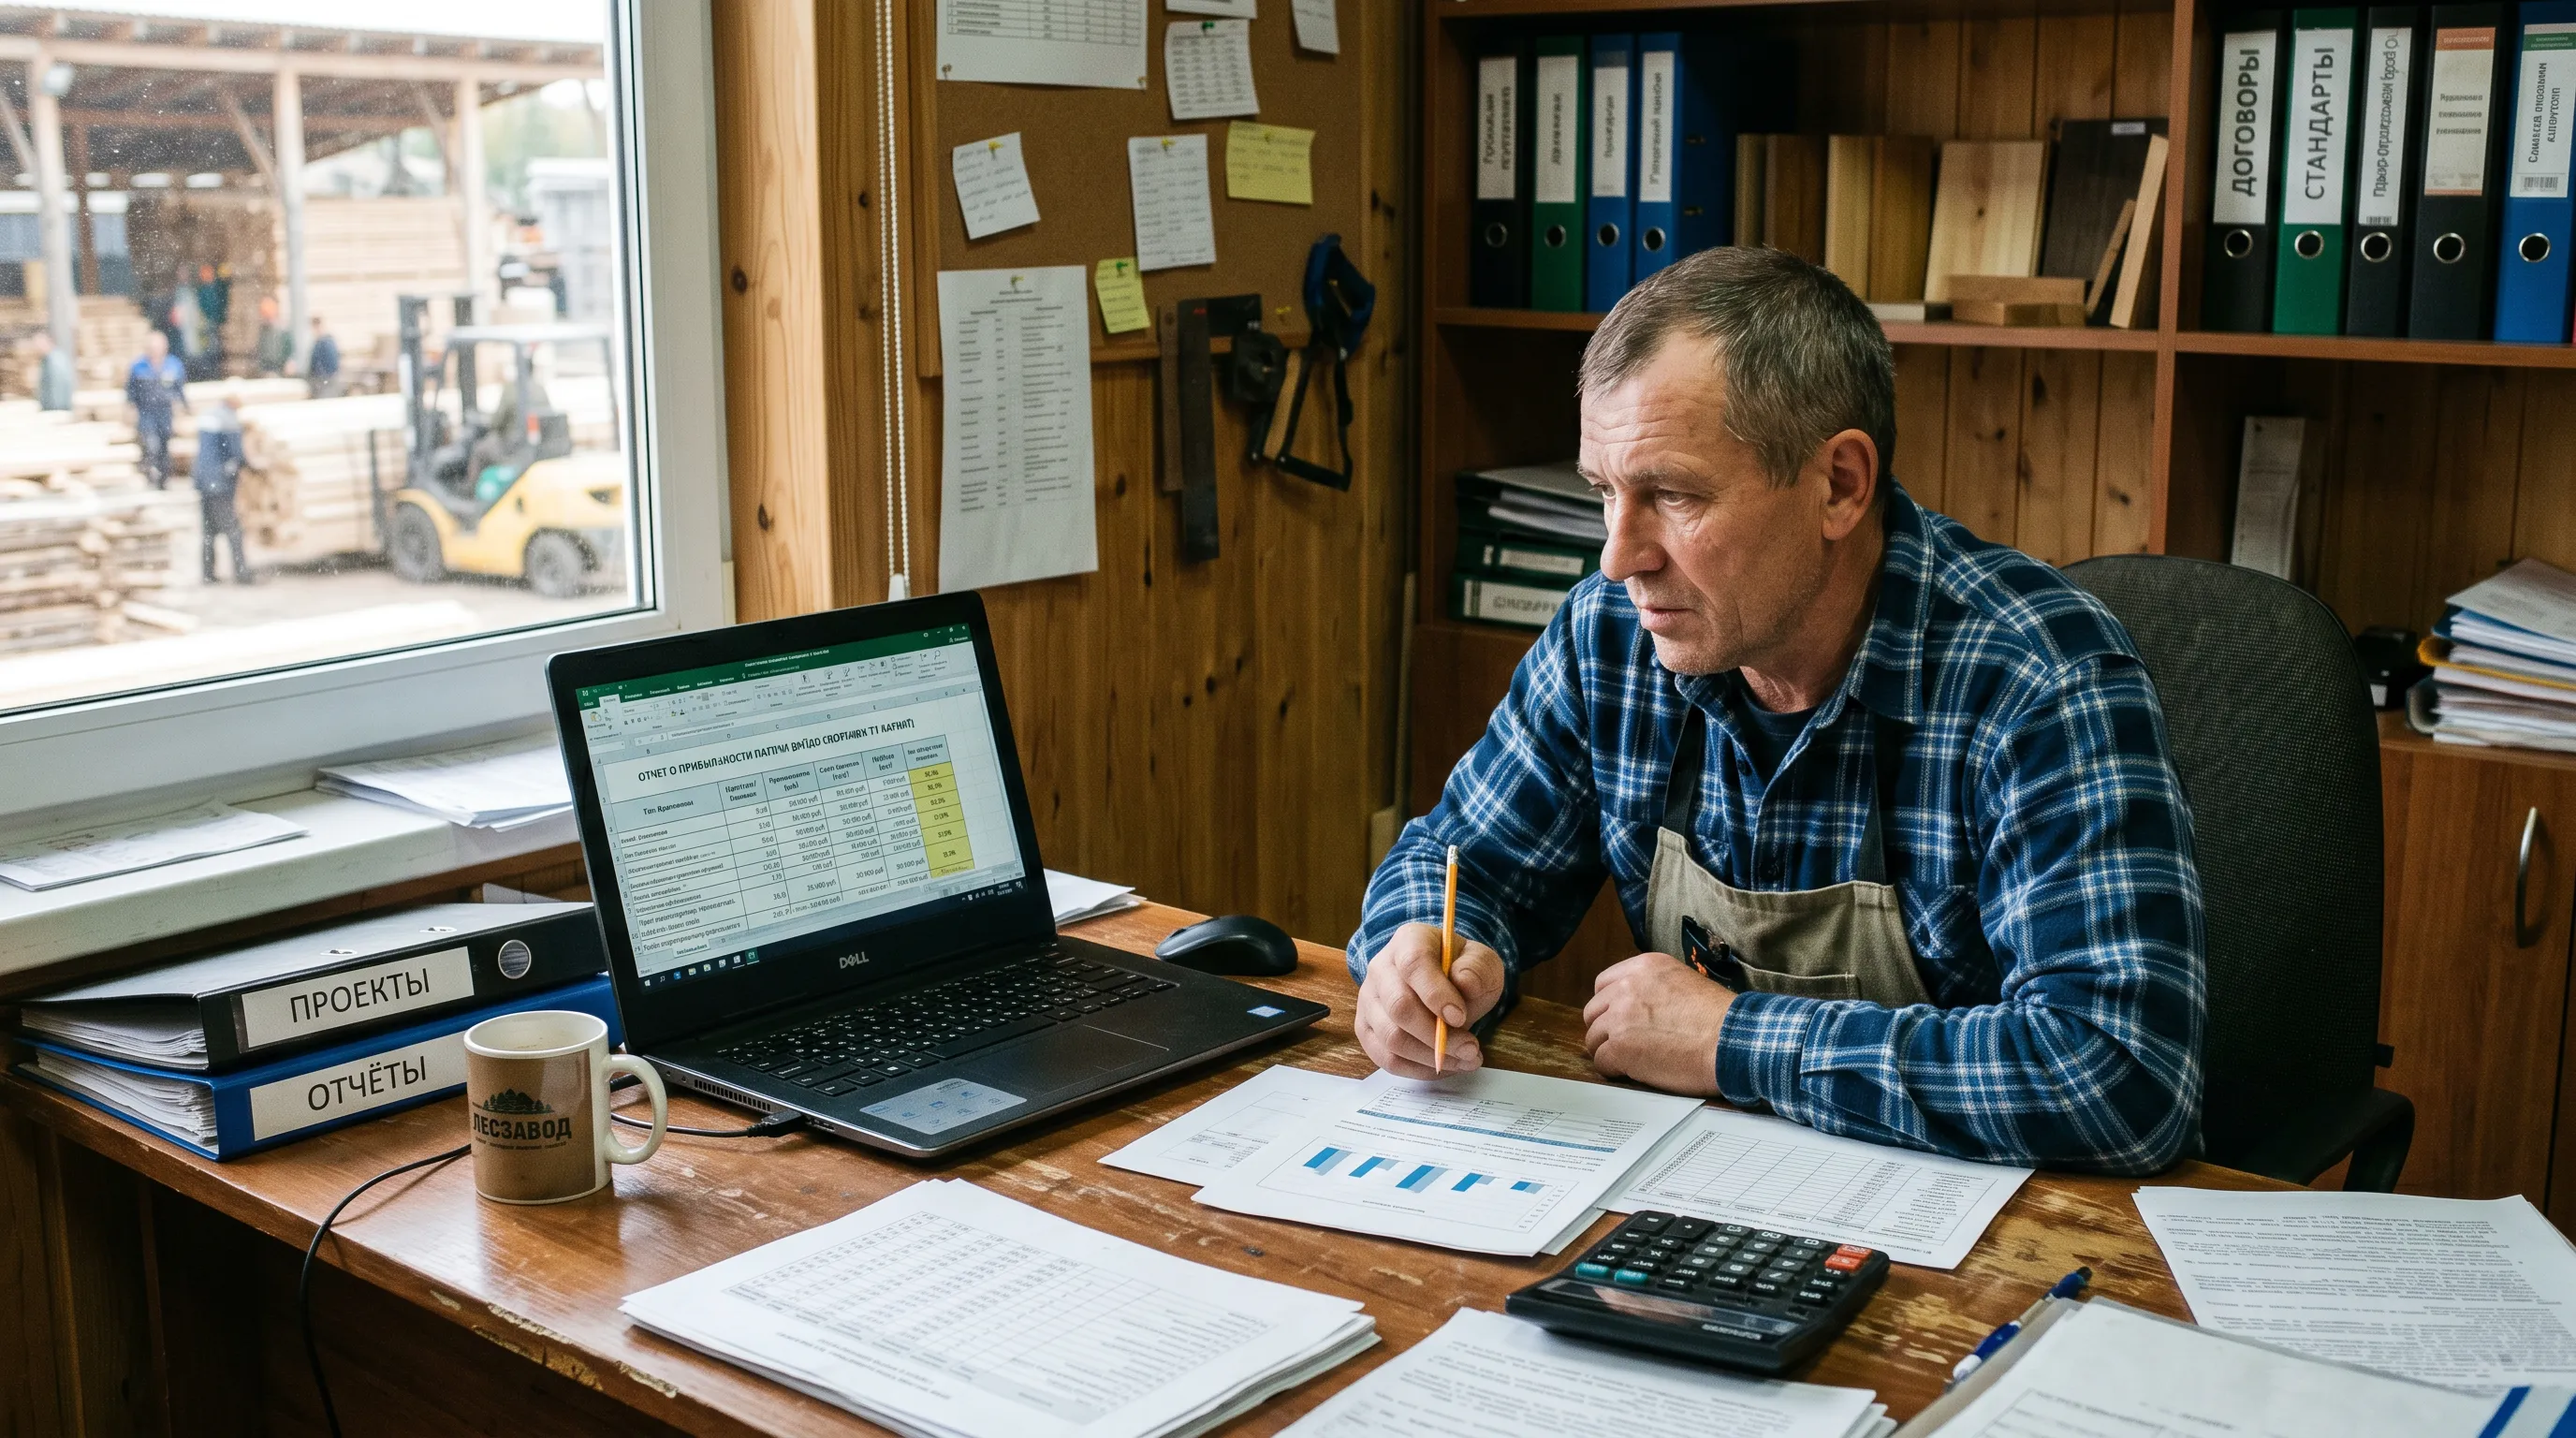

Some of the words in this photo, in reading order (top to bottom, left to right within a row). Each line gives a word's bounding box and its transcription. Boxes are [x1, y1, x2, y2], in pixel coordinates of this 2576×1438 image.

[2232, 48, 2261, 198] ДОГОВОРЫ
[2305, 47, 2335, 200] СТАНДАРТЫ
[289, 967, 430, 1023] ПРОЕКТЫ
[307, 1055, 427, 1111] ОТЧЁТЫ
[473, 1112, 573, 1141] ЛЕСЗАВОД
